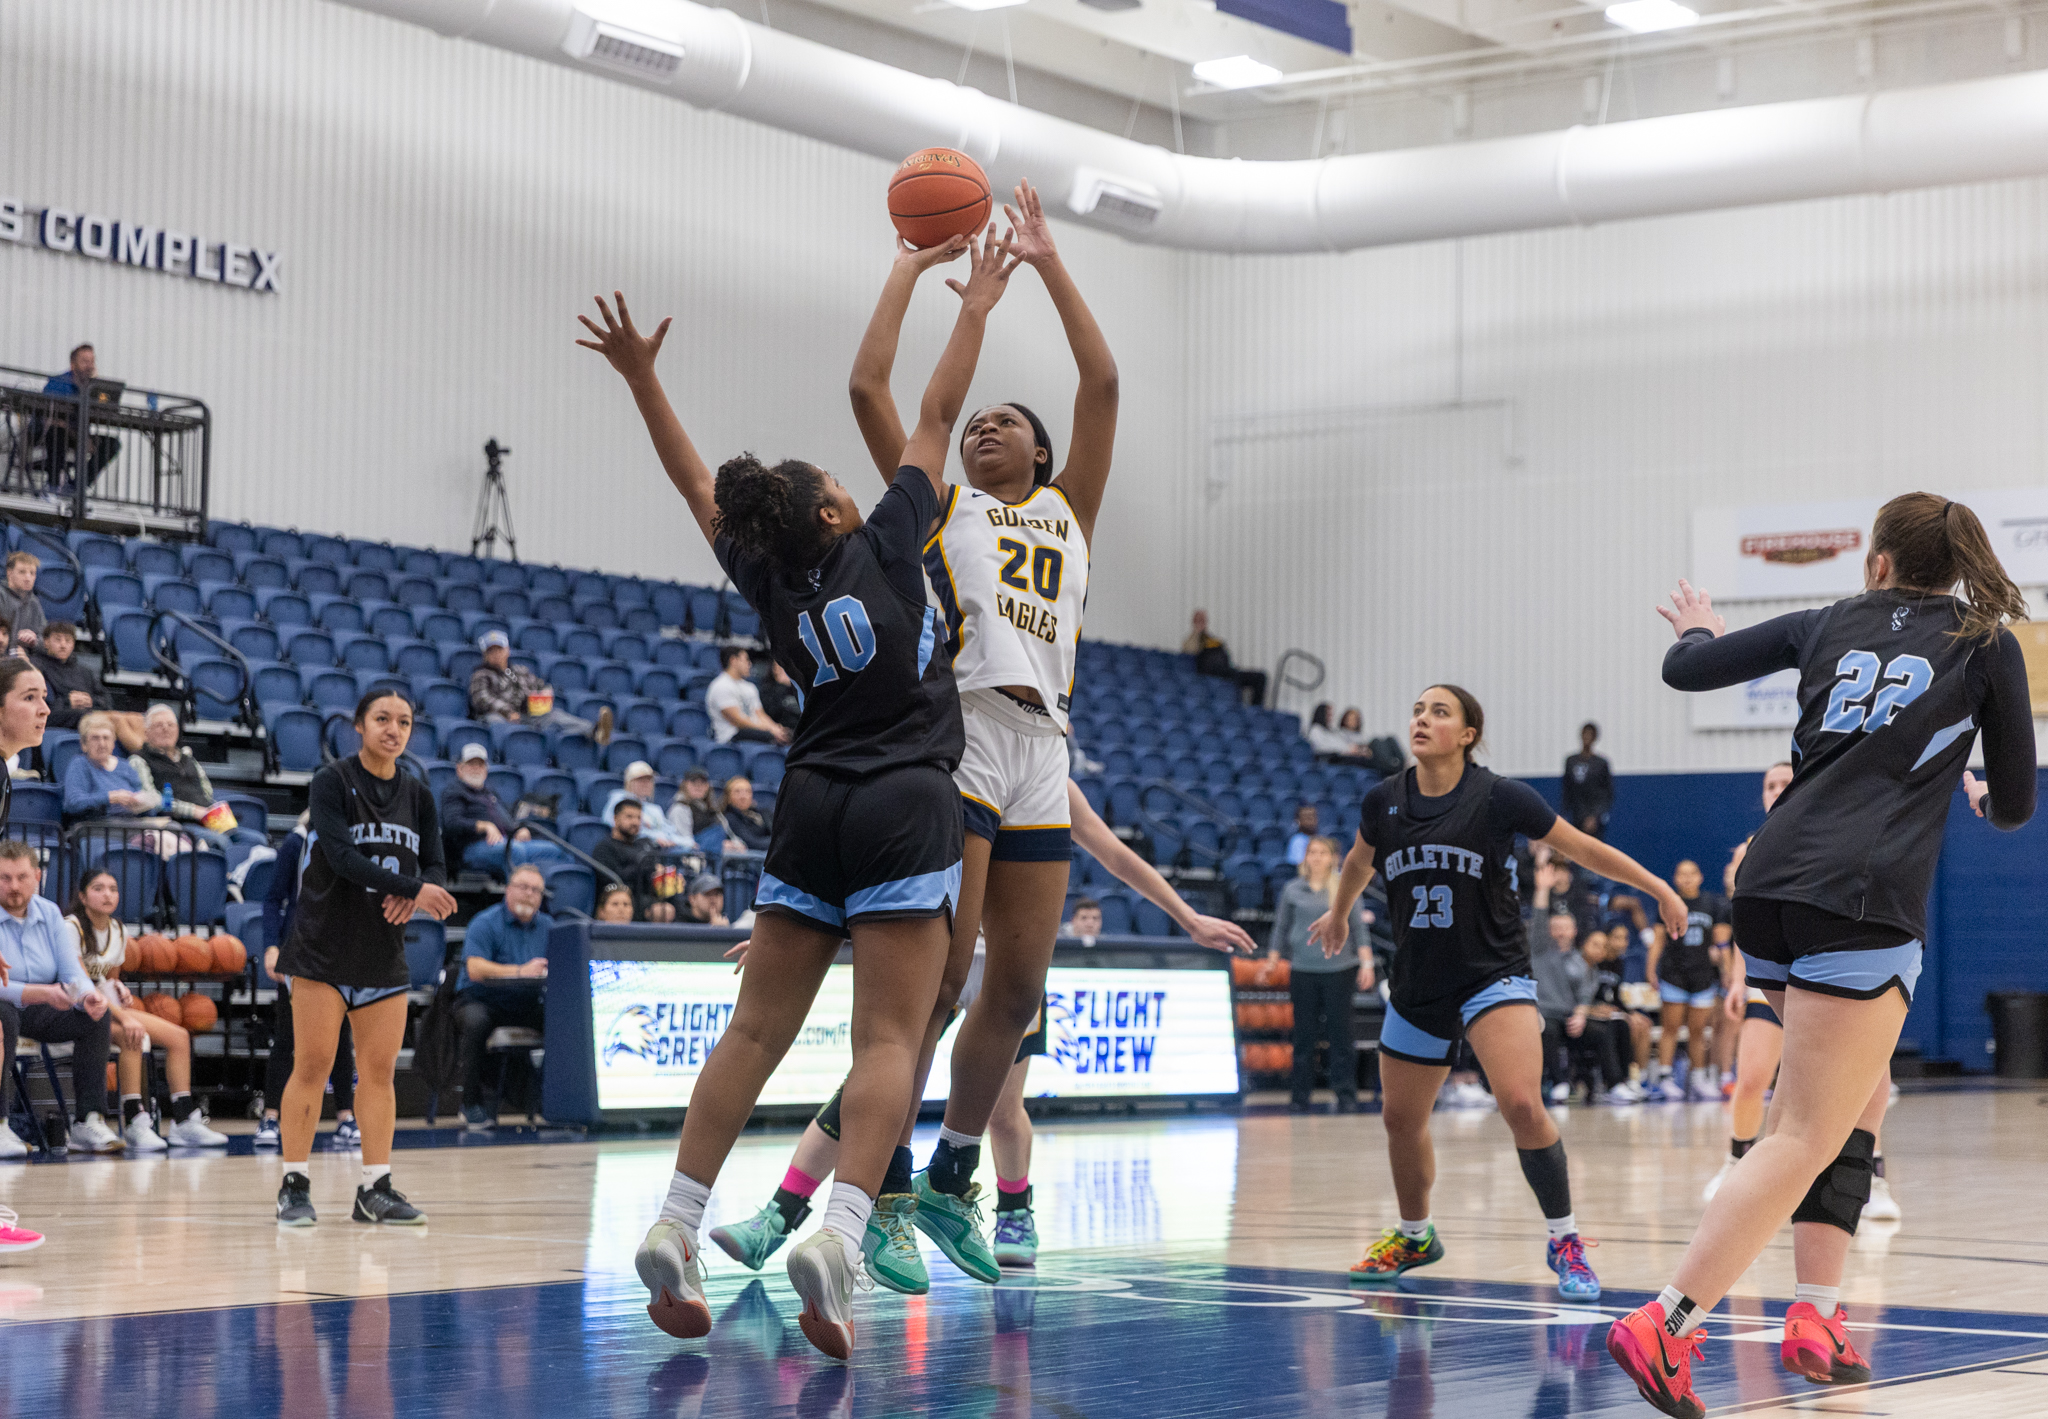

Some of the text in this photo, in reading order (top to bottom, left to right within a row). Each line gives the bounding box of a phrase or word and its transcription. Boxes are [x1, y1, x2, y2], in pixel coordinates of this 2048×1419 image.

[41, 207, 282, 295] COMPLEX
[997, 536, 1064, 603] 20
[798, 594, 877, 687] 10
[1820, 649, 1935, 734] 22
[1384, 844, 1484, 882] GILLETTE
[1409, 884, 1454, 929] 23
[656, 1003, 734, 1031] FLIGHT
[1073, 991, 1166, 1029] FLIGHT
[1075, 1036, 1156, 1074] CREW
